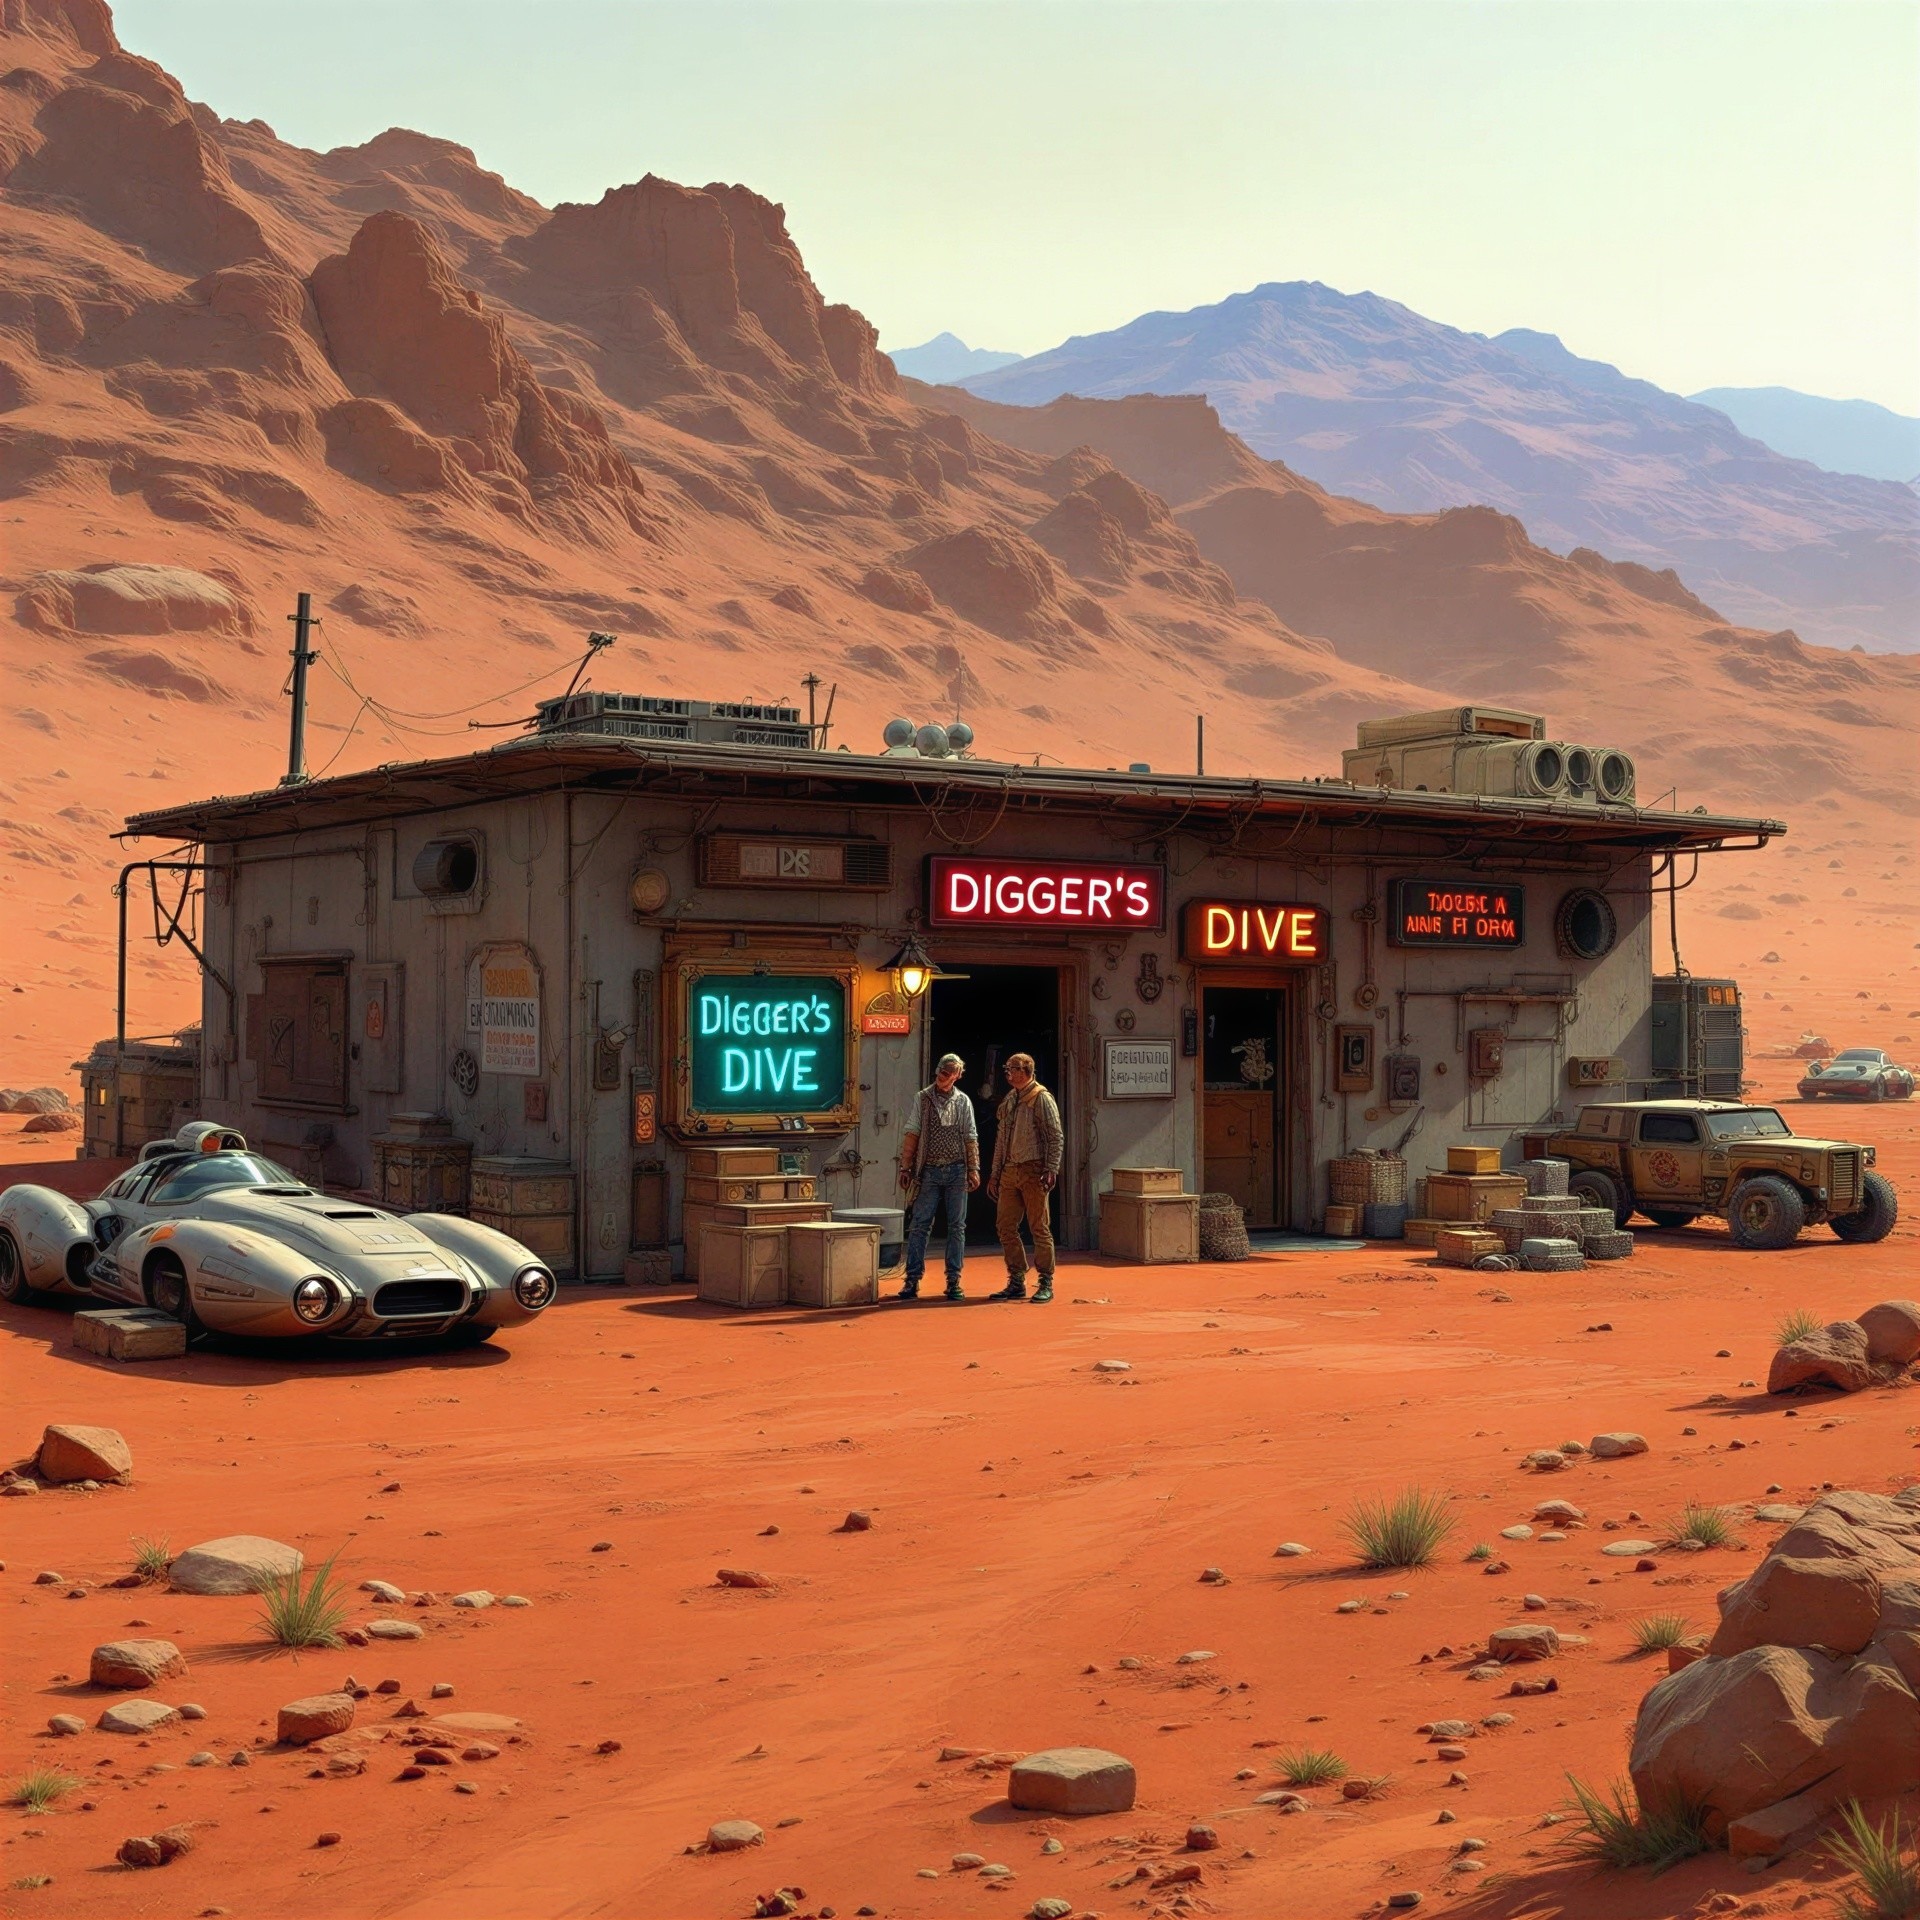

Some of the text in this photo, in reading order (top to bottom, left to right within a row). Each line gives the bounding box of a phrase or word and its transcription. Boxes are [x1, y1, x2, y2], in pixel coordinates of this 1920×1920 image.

[950, 872, 1150, 918] DIGGER'S
[1207, 907, 1317, 952] DIVE
[701, 994, 831, 1035] DIGGER'S
[722, 1047, 819, 1092] DIVE
